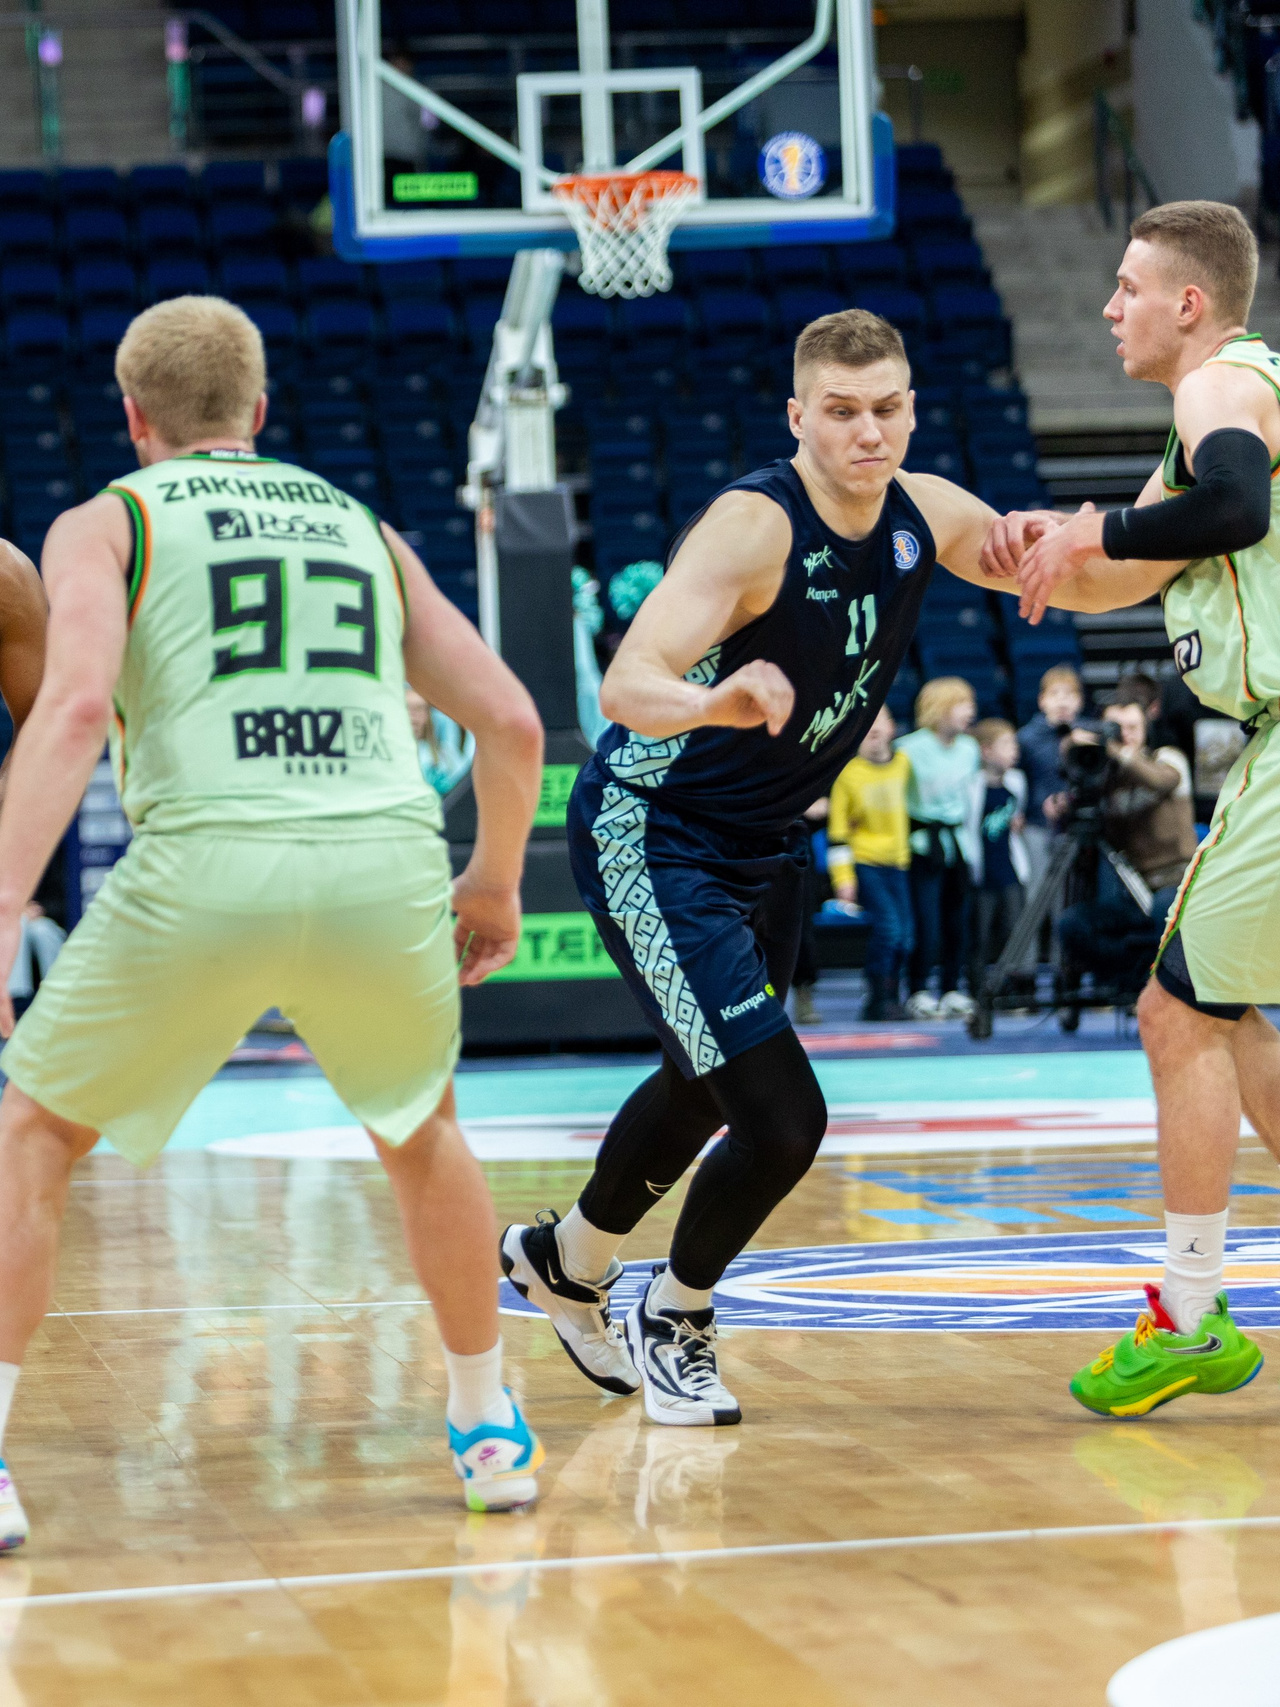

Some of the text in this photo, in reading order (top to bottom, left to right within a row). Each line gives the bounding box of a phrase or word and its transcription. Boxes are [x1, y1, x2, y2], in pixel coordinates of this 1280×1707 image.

[207, 556, 381, 683] 93
[845, 594, 877, 656] 11
[719, 991, 766, 1021] Kempa
